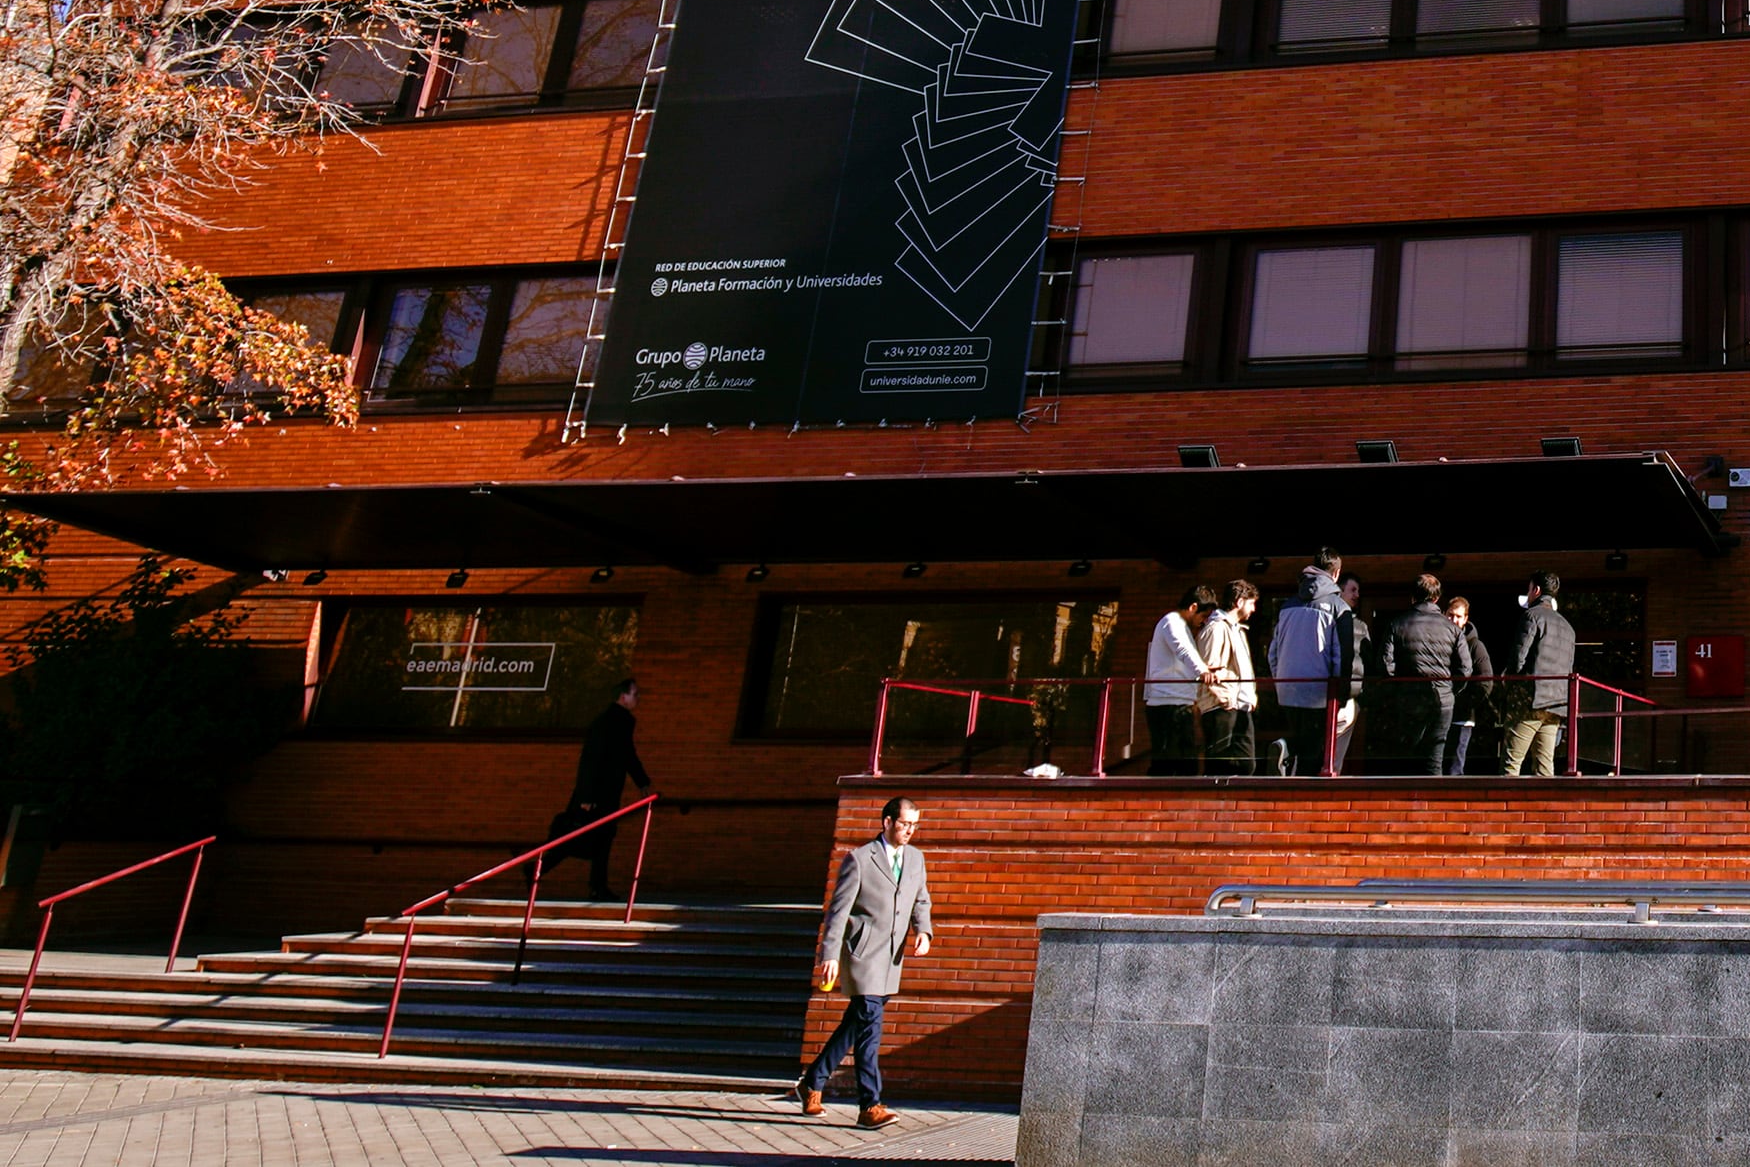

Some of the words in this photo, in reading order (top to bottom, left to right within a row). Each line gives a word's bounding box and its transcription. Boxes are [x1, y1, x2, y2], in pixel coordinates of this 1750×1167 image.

[655, 263, 673, 273] RED
[674, 262, 686, 272] DE
[687, 258, 741, 271] EDUCACIÓN
[742, 258, 786, 269] SUPERIOR
[670, 279, 715, 293] Planeta
[717, 276, 783, 291] Formación
[783, 279, 794, 293] y
[796, 272, 883, 289] Universidades
[635, 348, 681, 368] Grupo
[709, 346, 766, 362] Planeta
[883, 346, 904, 358] +34
[906, 345, 927, 357] 919
[929, 345, 950, 356] 032
[953, 344, 974, 356] 201
[633, 371, 656, 397] 75
[685, 371, 700, 392] de
[703, 371, 719, 388] tu
[723, 377, 757, 387] mano
[870, 374, 977, 386] universidadunie.com
[1695, 643, 1712, 658] 41
[406, 656, 535, 674] eaemadrid.com
